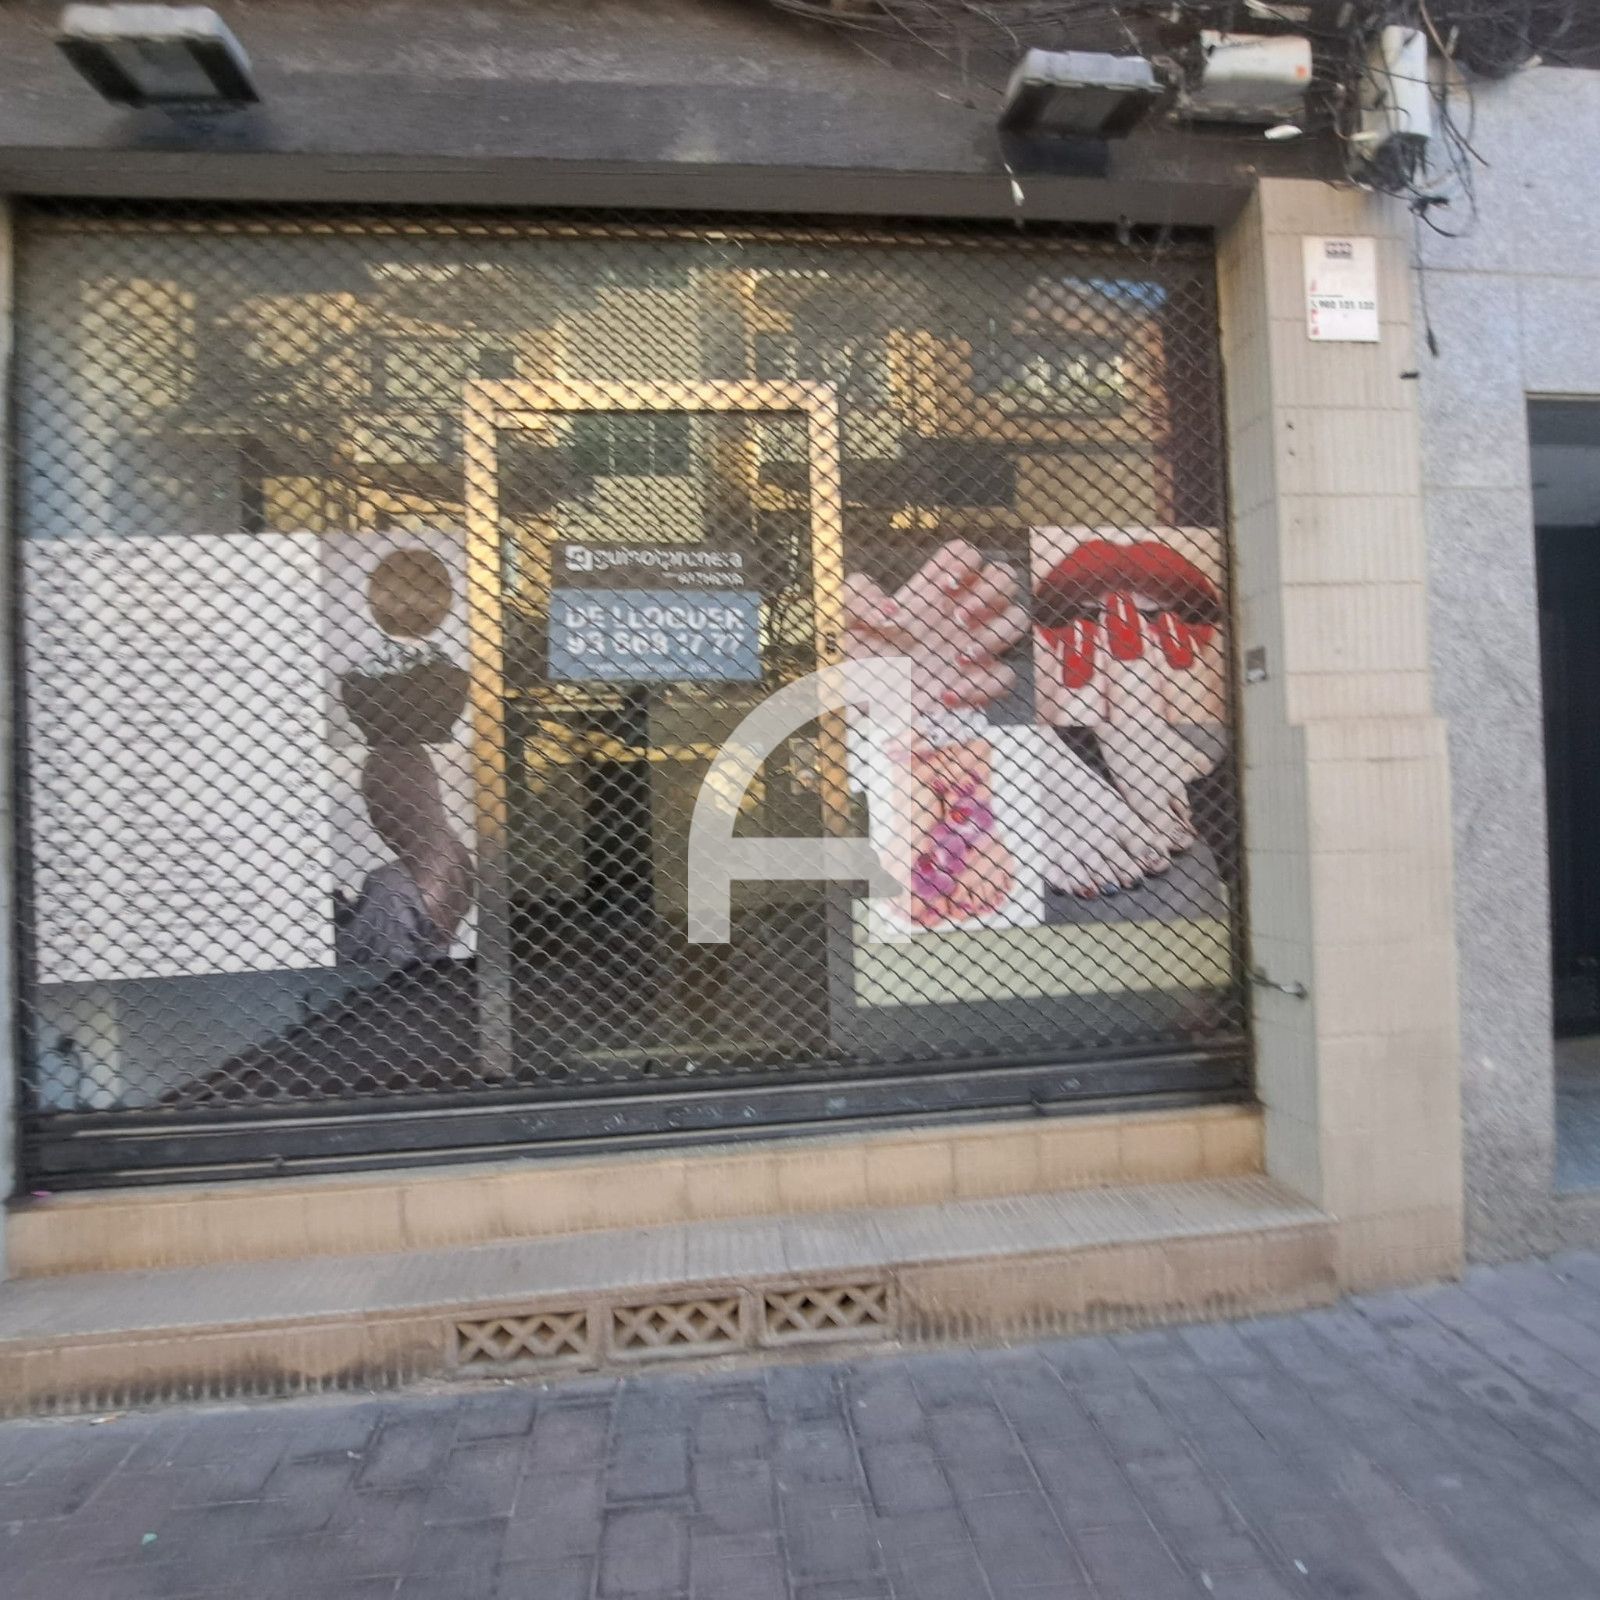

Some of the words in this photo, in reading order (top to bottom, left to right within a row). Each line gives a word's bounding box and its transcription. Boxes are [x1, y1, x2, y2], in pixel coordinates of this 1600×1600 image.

[565, 605, 606, 629] DE
[612, 605, 745, 631] LLOQUER
[565, 631, 606, 655] 93
